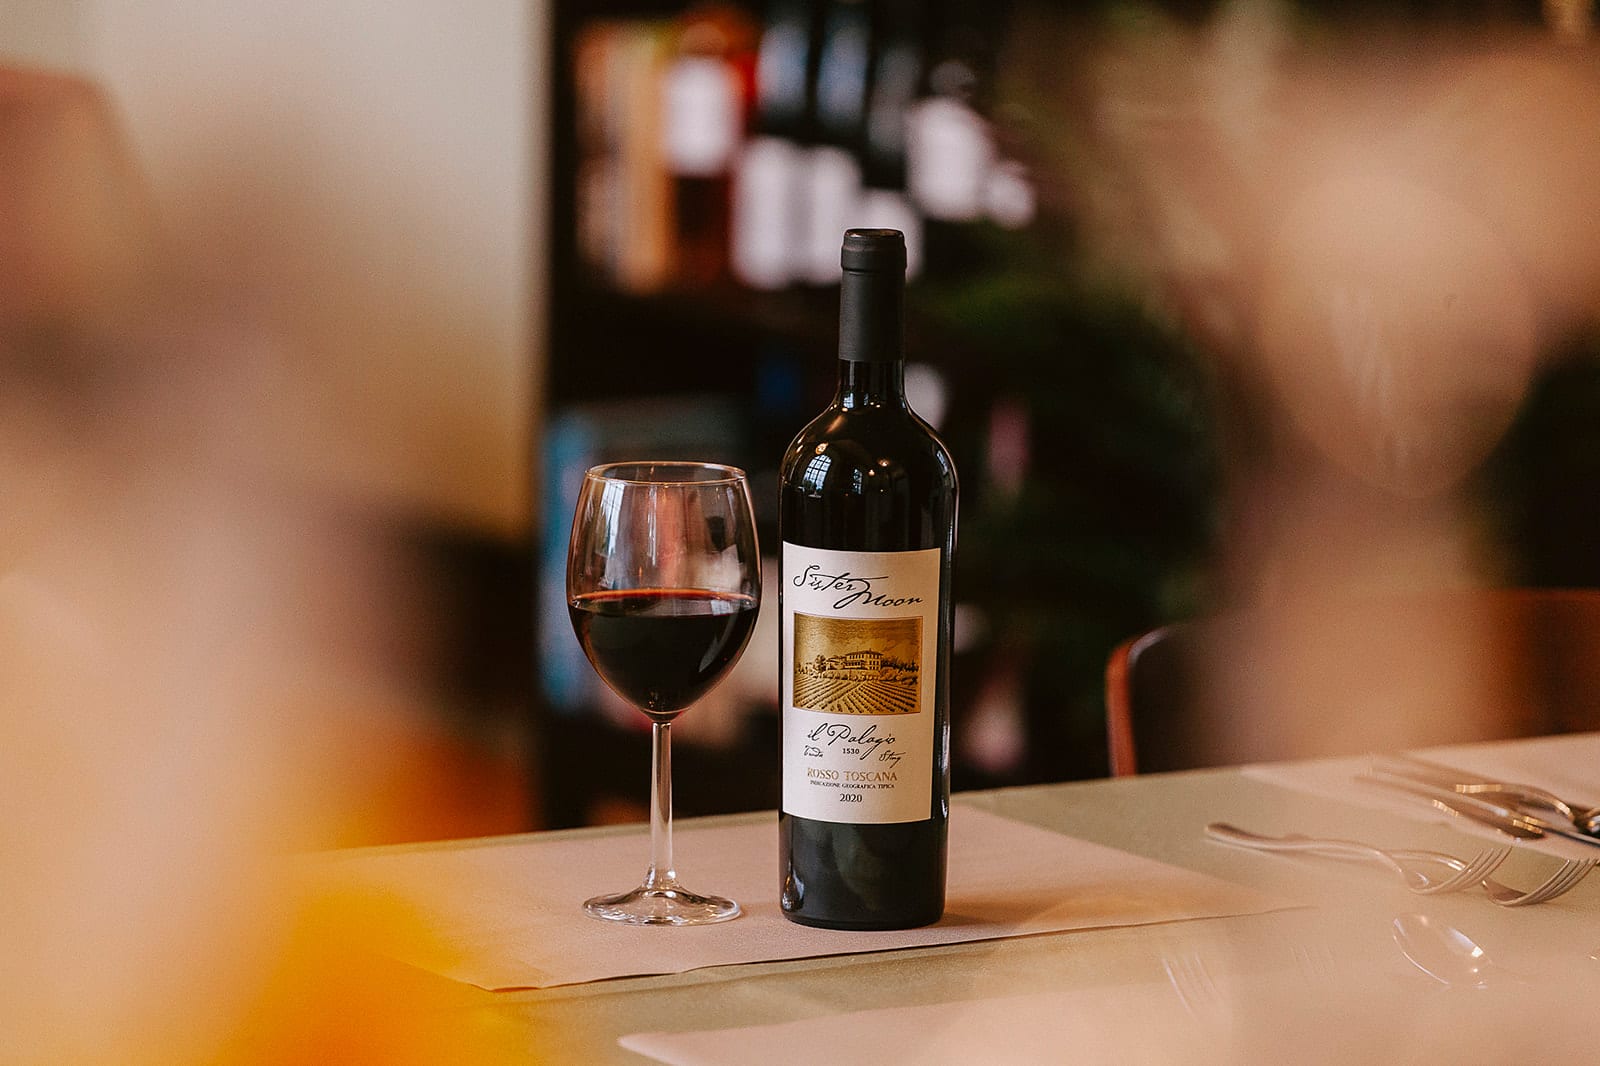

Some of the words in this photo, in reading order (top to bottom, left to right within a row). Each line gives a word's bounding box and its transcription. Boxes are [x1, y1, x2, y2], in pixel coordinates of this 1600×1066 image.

[793, 564, 889, 592] Sister
[832, 578, 923, 609] Moon
[826, 724, 897, 760] Palagio
[841, 747, 861, 755] 1530
[807, 768, 839, 780] ROSSO
[842, 770, 898, 782] TOSCANA
[839, 793, 863, 803] 2020
